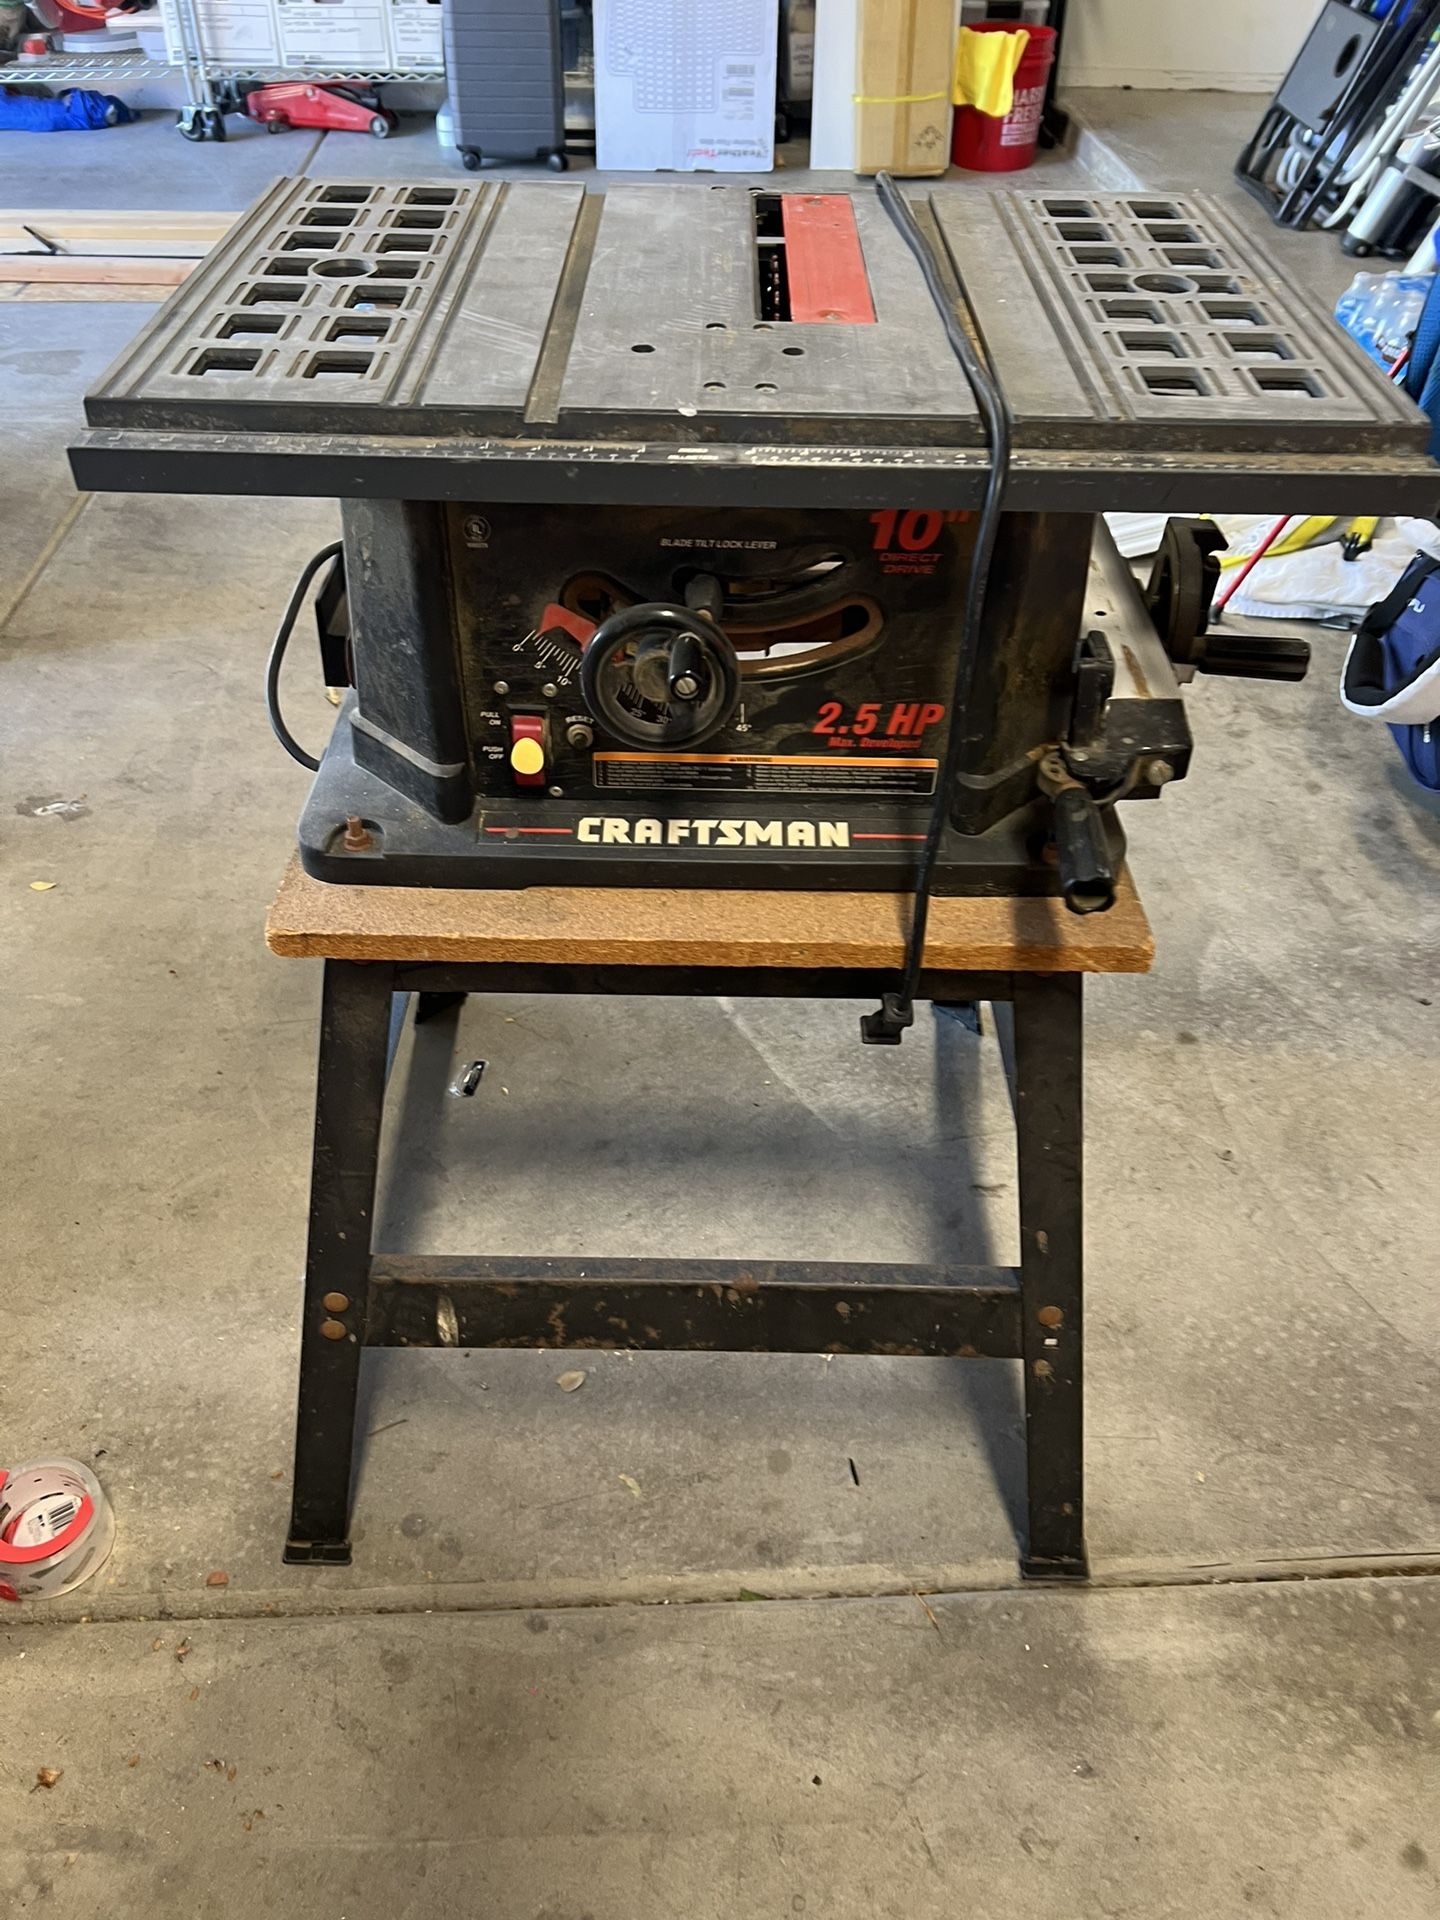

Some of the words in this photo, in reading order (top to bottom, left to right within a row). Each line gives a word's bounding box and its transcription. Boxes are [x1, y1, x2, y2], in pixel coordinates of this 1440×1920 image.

[660, 538, 693, 547] BLADE
[695, 539, 715, 548] TILT
[716, 540, 743, 549] LOCK
[744, 541, 777, 549] LEVER
[880, 552, 944, 562] DIRECT
[883, 564, 936, 574] DRIVE
[565, 715, 594, 724] RESET
[812, 702, 882, 735] 2.5
[886, 703, 945, 735] HP
[577, 817, 850, 847] CRAFTSMAN
